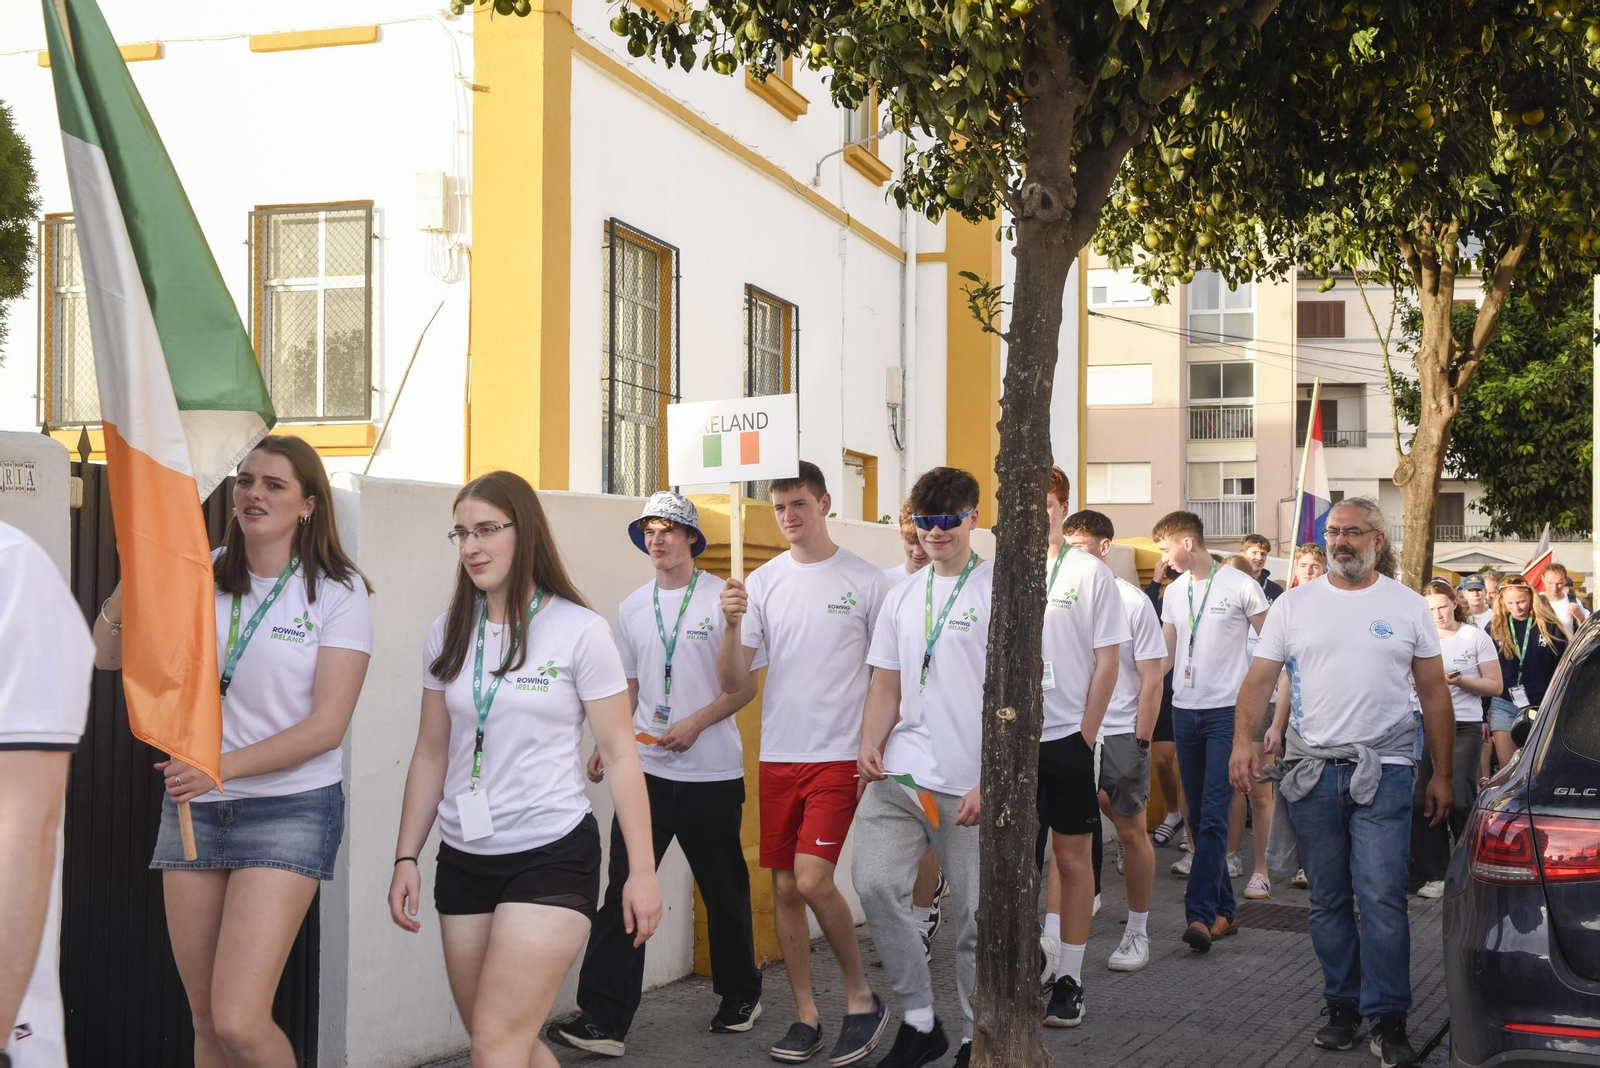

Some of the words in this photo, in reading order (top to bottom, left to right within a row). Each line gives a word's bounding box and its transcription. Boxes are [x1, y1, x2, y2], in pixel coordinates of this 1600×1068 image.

[698, 411, 769, 435] RELAND
[949, 619, 971, 627] ROWING
[272, 626, 306, 638] ROWING
[270, 632, 305, 644] IRELAND
[516, 677, 550, 686] ROWING
[515, 683, 549, 693] IRELAND
[1553, 787, 1598, 796] GLC
